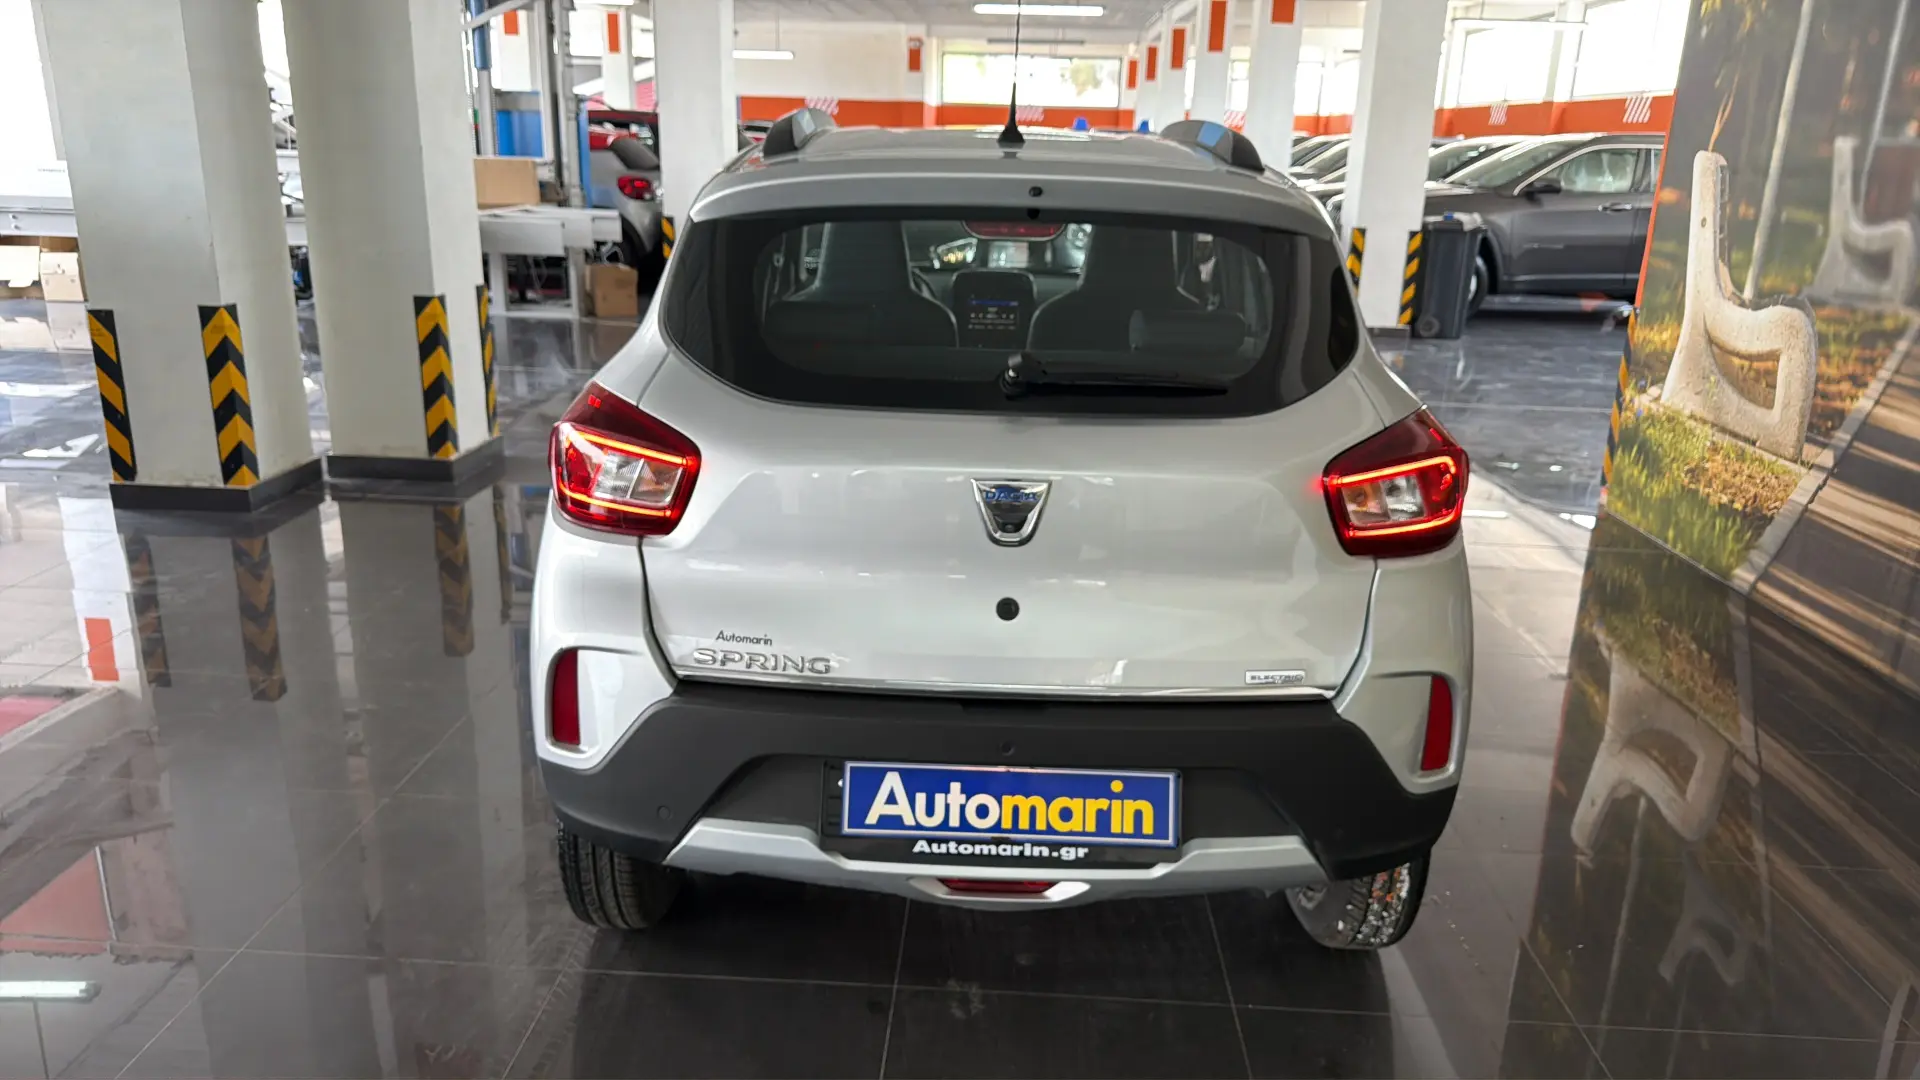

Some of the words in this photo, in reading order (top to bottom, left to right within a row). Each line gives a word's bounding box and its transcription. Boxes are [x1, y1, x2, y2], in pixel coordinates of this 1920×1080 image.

[716, 630, 773, 646] Automarin
[693, 647, 832, 675] SPRING
[864, 771, 1154, 835] Automarin
[912, 839, 1089, 860] Automarin.gr
